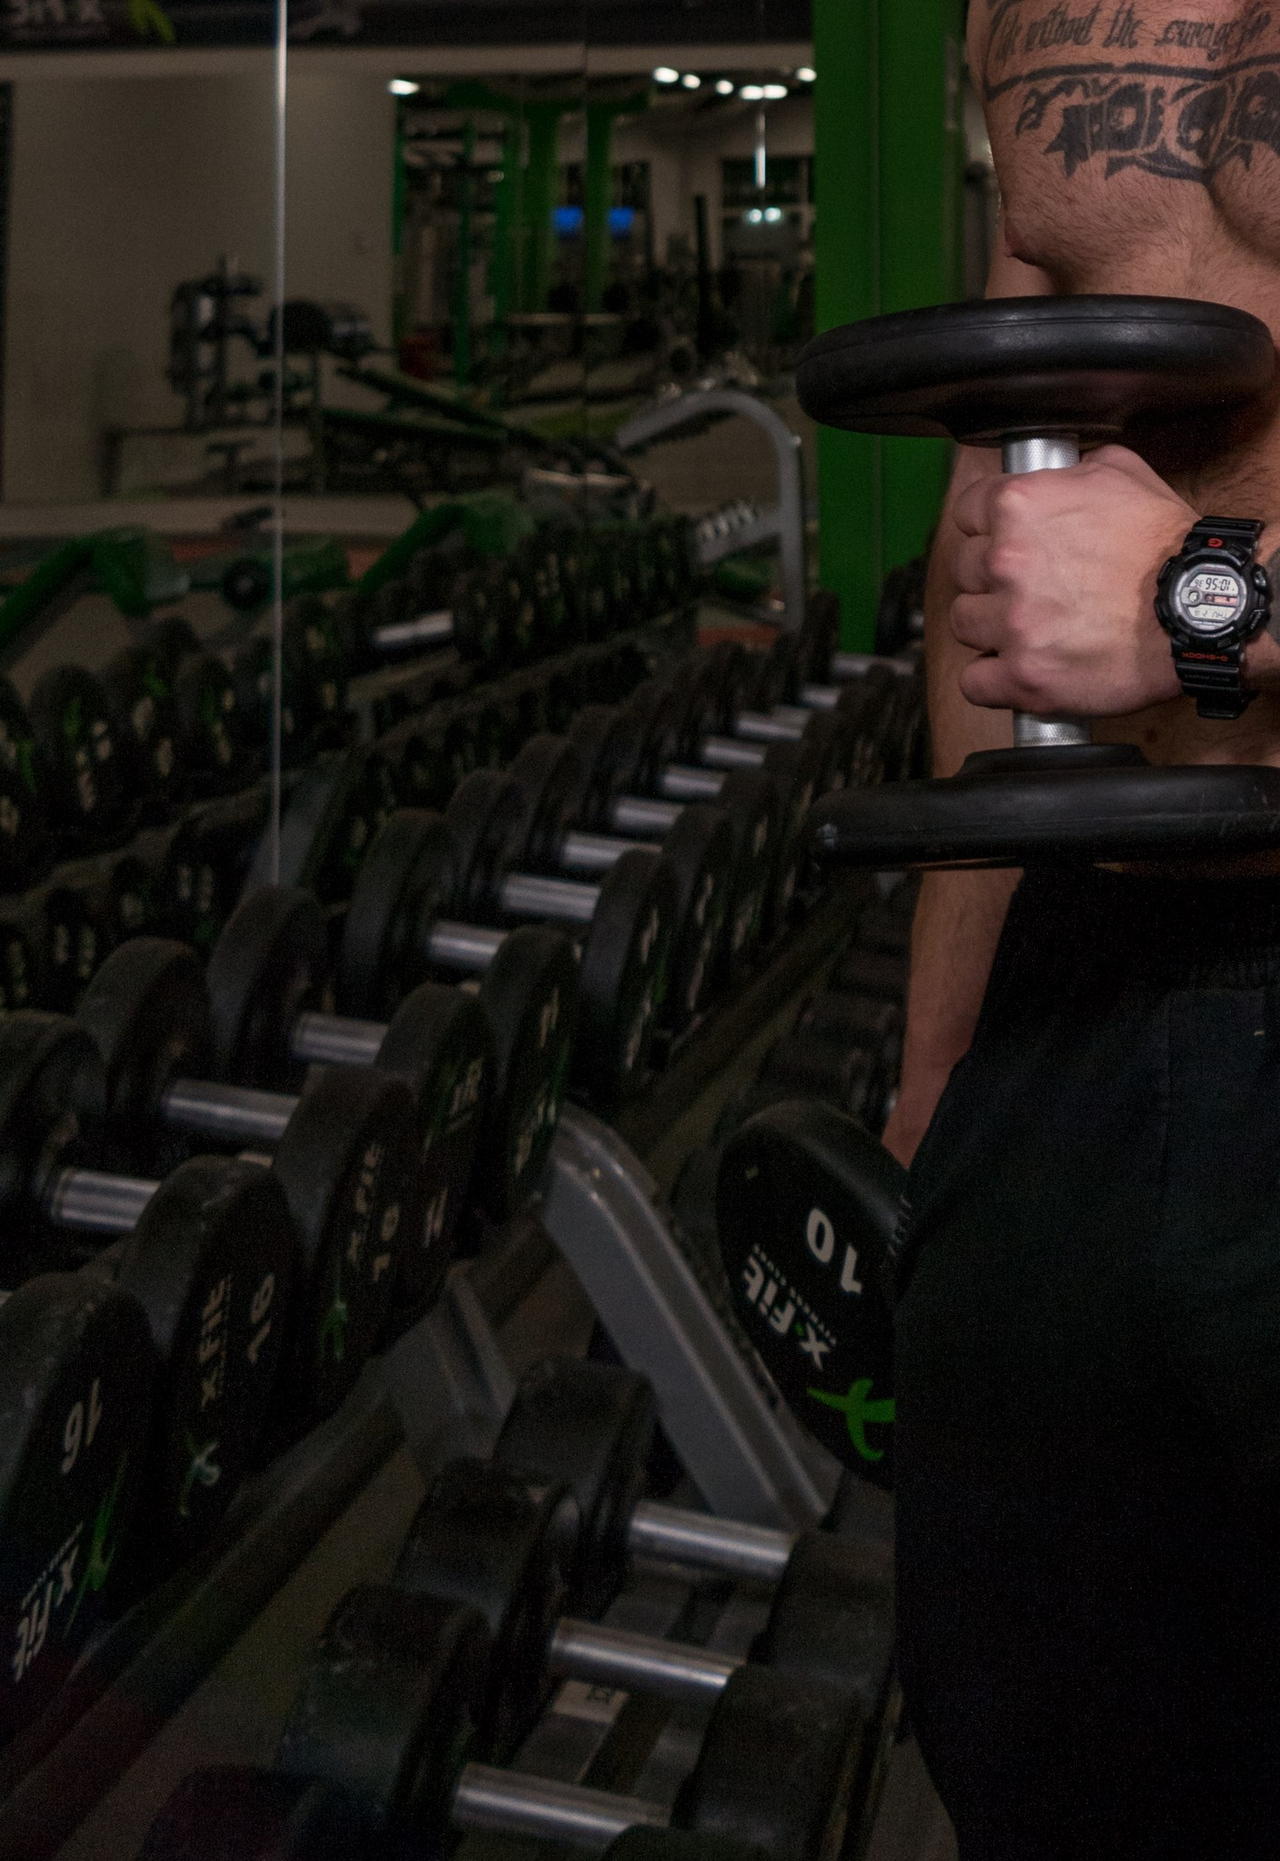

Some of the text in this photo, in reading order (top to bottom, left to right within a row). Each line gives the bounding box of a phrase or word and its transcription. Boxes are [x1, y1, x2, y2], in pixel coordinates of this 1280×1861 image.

[1103, 0, 1144, 49] the
[1182, 651, 1229, 662] G-SHOCK
[806, 1207, 863, 1295] 10
[61, 1377, 101, 1475] 16
